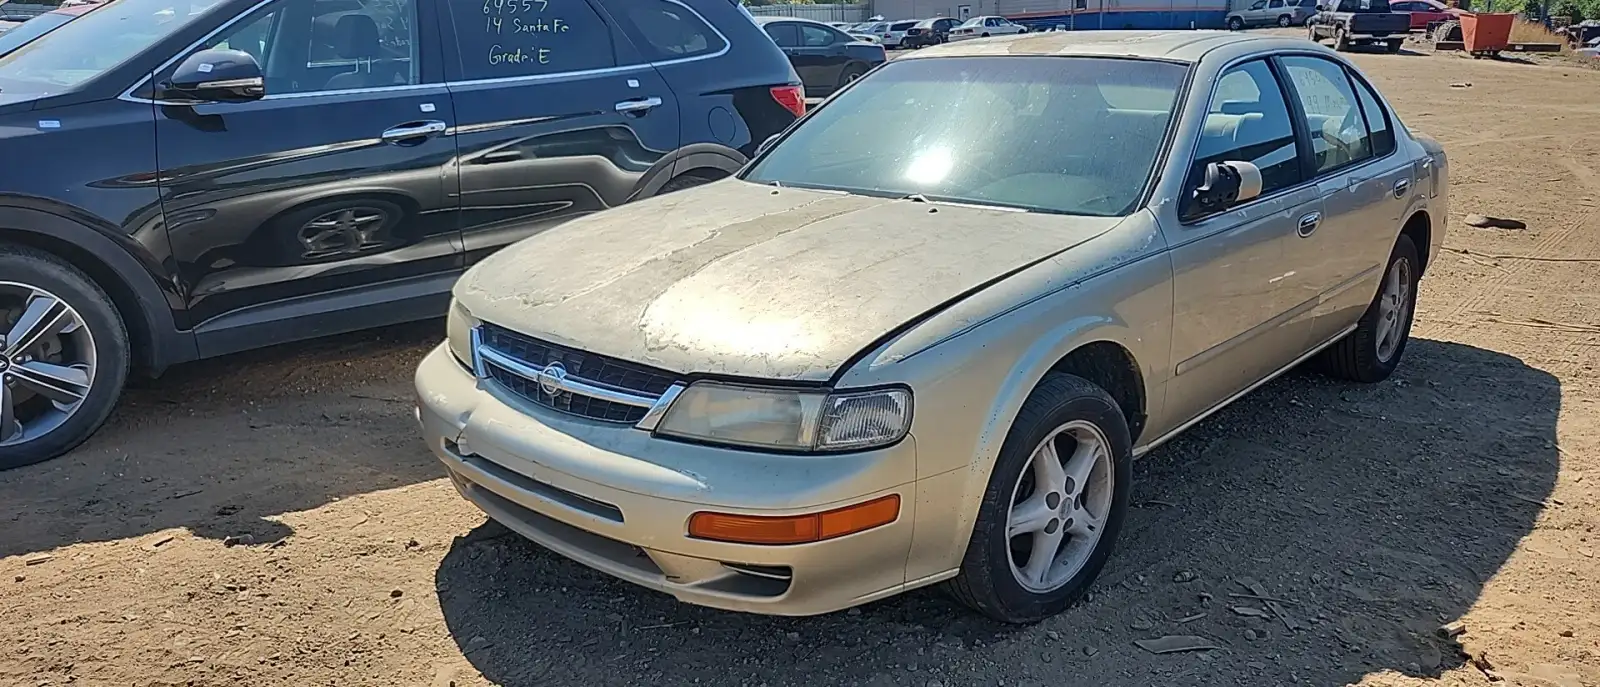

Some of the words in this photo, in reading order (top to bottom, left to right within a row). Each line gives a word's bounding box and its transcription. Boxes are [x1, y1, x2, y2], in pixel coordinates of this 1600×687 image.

[486, 16, 503, 35] 14
[513, 17, 550, 34] Santa
[553, 19, 570, 33] Fe
